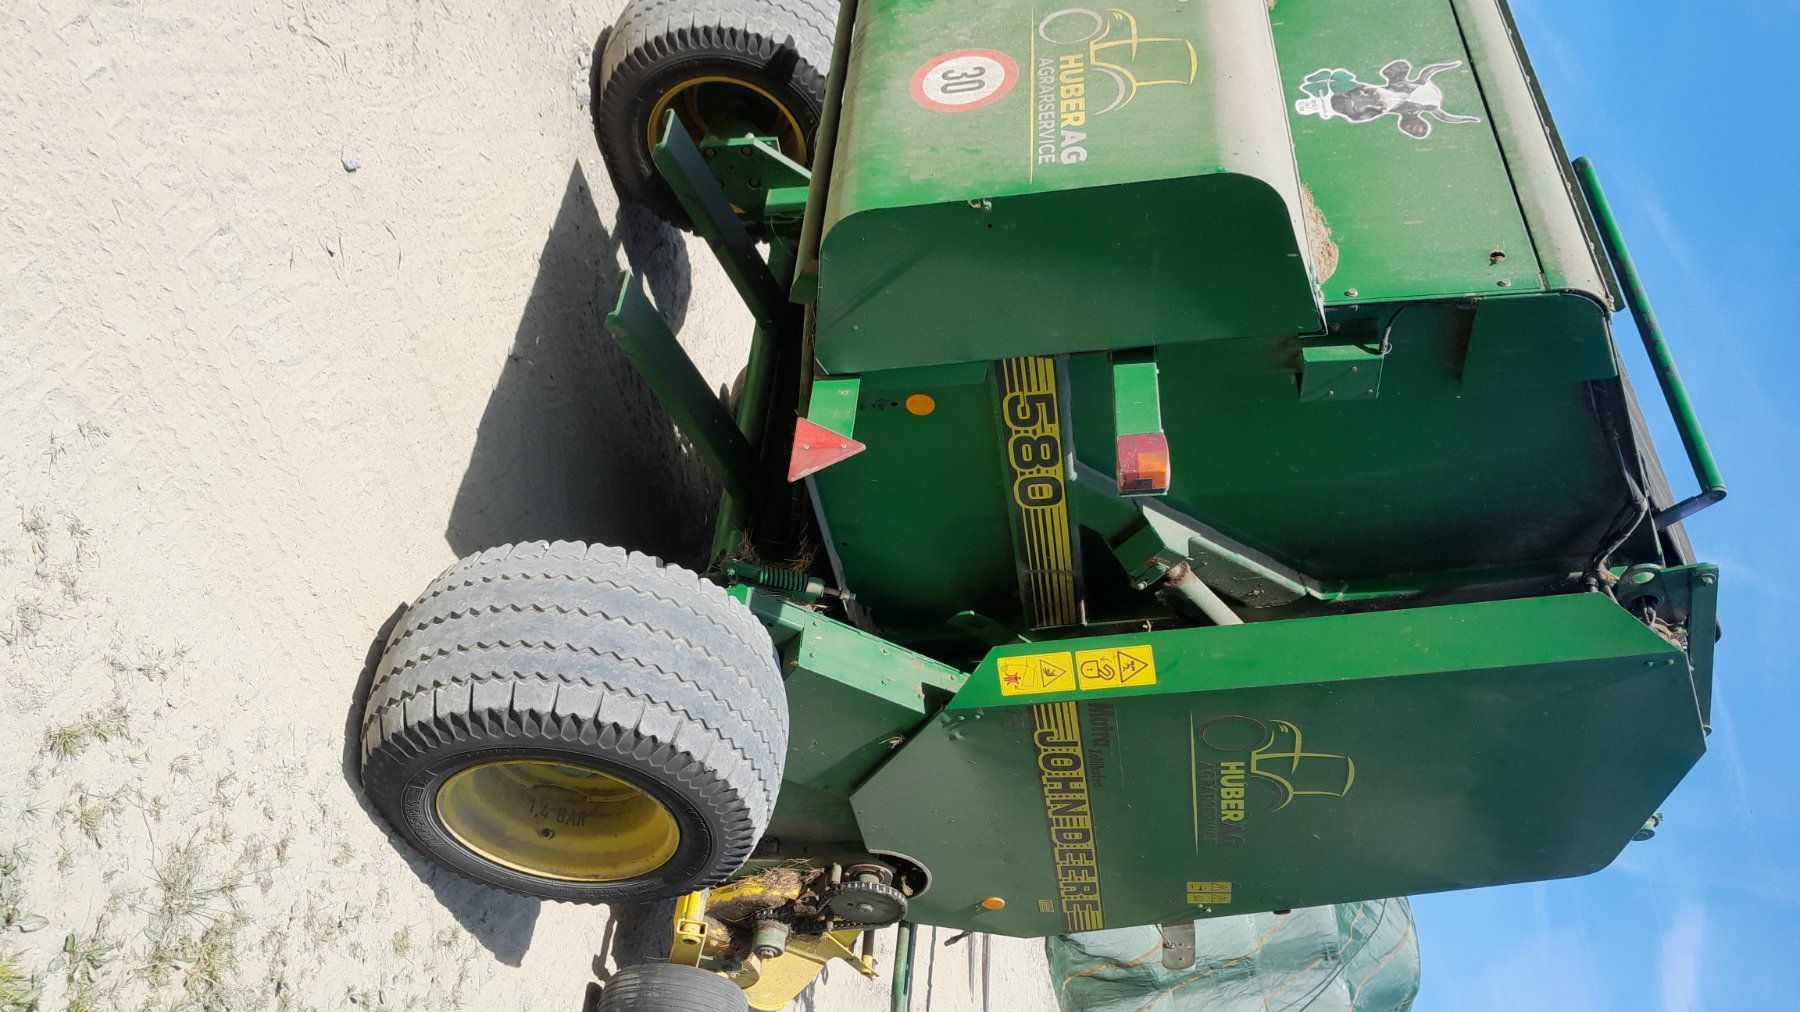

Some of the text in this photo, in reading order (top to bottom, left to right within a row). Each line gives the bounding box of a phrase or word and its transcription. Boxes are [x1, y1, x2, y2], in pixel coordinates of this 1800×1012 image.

[941, 66, 986, 94] 30
[1038, 58, 1056, 165] AGRARSERVICE
[1059, 53, 1088, 165] HUBER AG
[1006, 393, 1063, 507] 580
[556, 808, 588, 827] BAR
[1037, 730, 1101, 912] JOHN DEERE
[1220, 761, 1245, 821] HUBER
